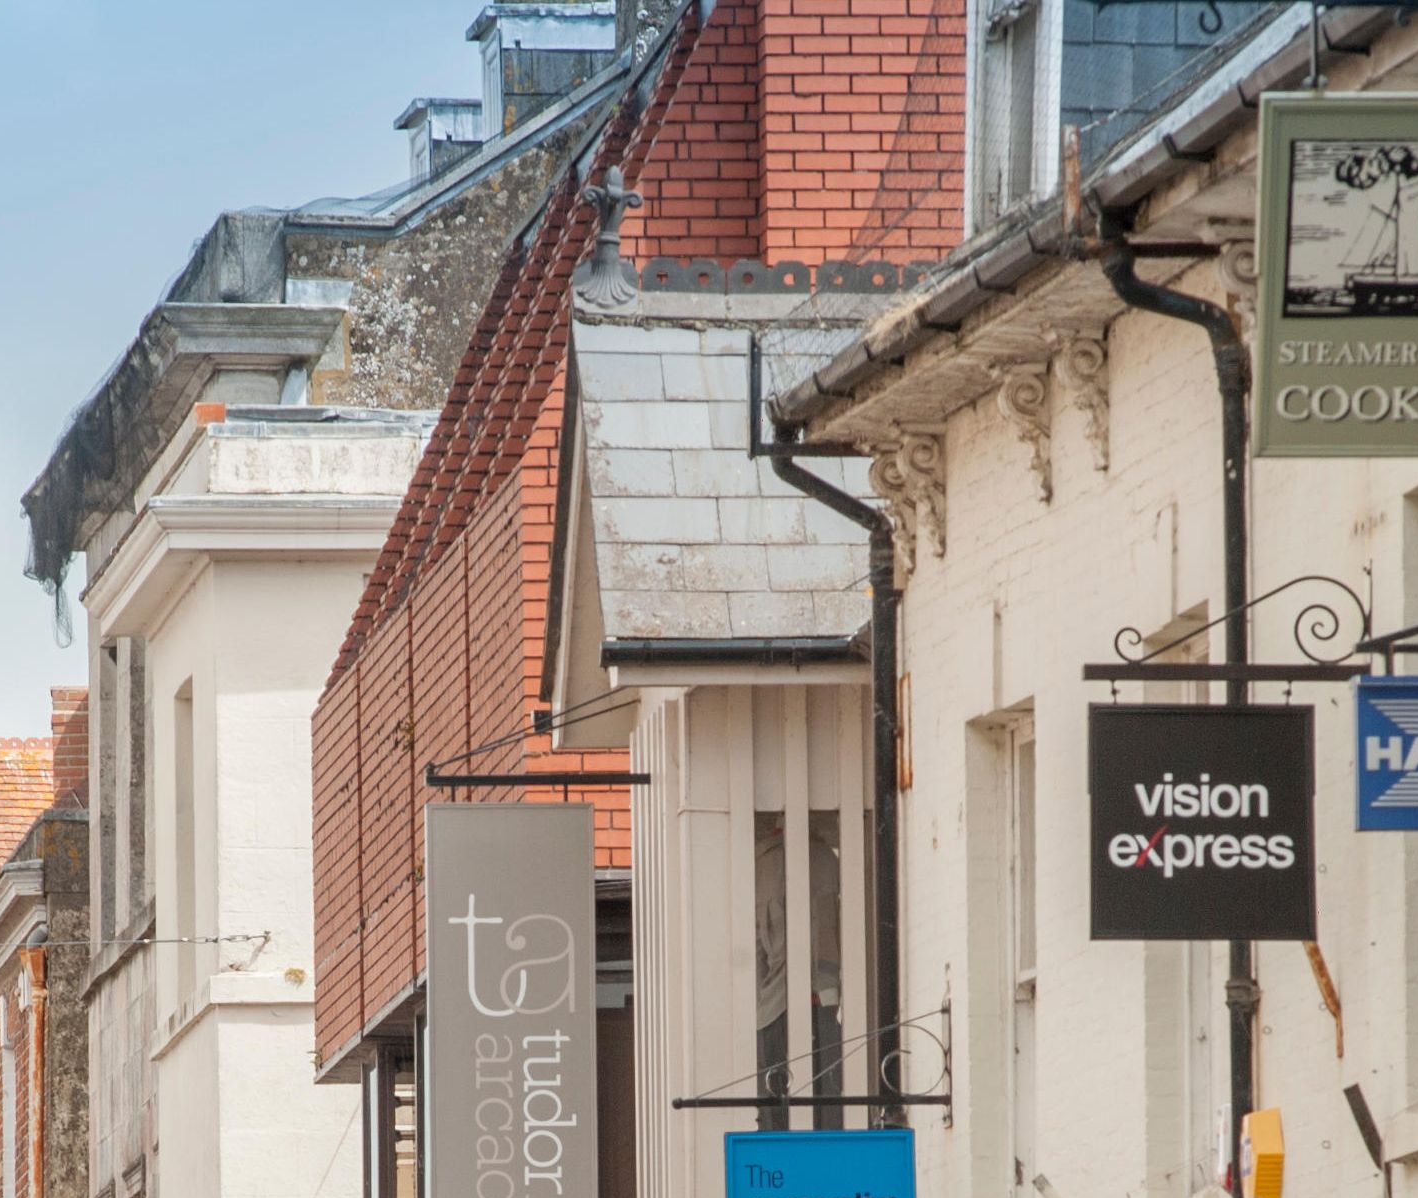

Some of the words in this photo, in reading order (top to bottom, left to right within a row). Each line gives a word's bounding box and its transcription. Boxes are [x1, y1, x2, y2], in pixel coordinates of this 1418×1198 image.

[1279, 339, 1417, 366] STEAMER
[1135, 772, 1269, 818] vision
[1108, 825, 1295, 878] express
[522, 1029, 577, 1195] tudor
[746, 1164, 784, 1189] The
